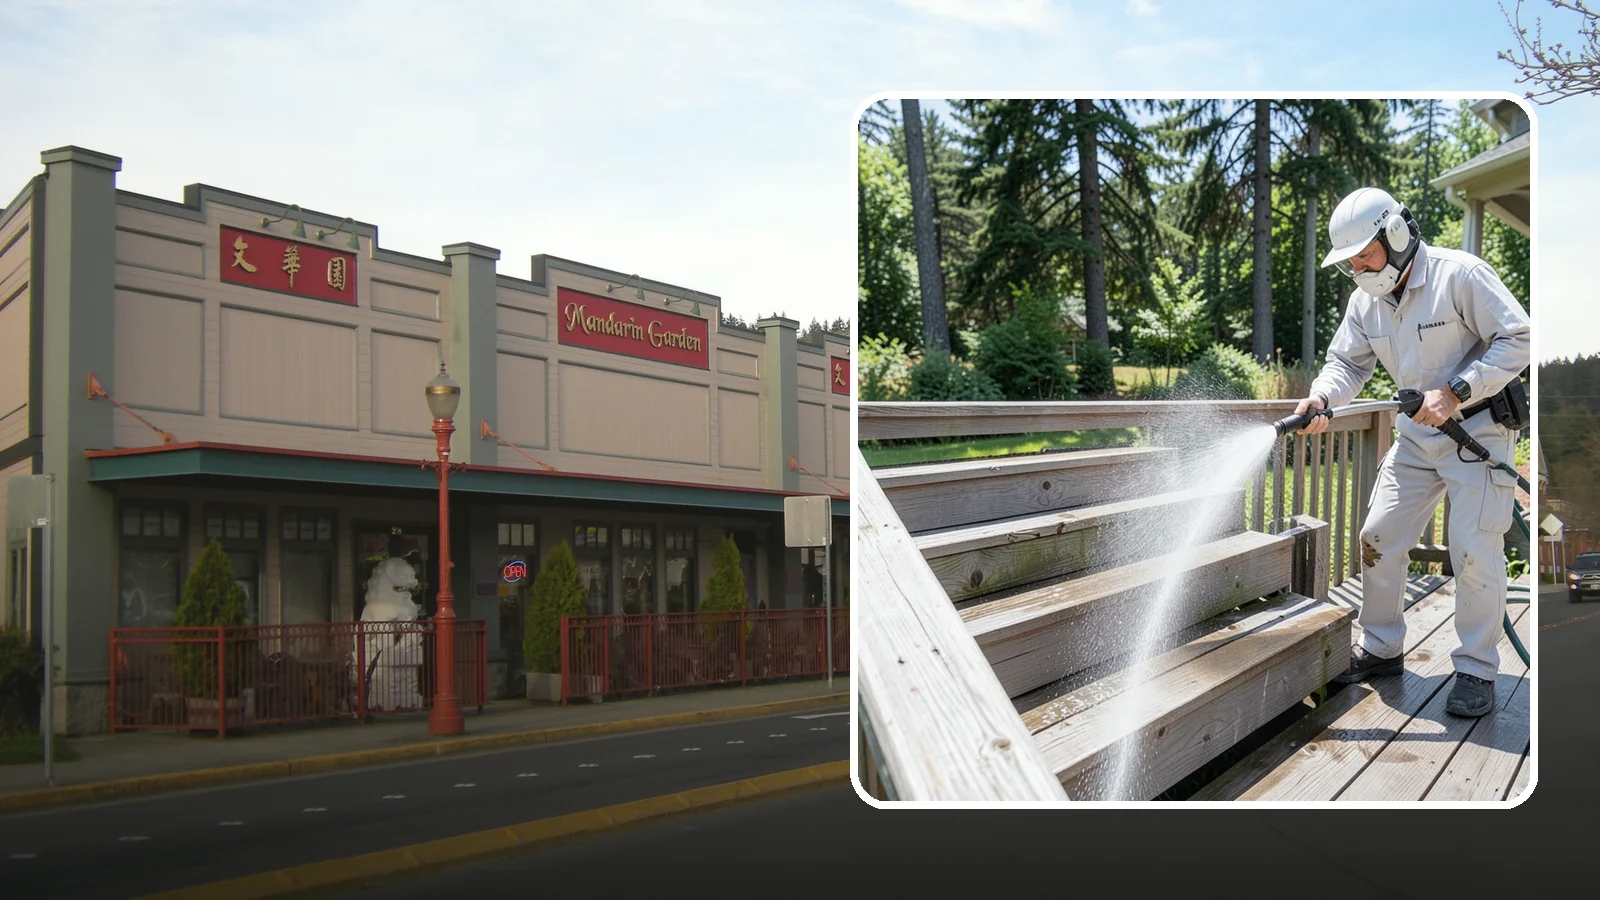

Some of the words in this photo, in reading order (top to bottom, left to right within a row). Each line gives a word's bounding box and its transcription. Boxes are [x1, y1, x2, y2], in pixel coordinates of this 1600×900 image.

[231, 236, 346, 290] 文華園
[564, 302, 644, 341] Mandarin
[648, 320, 701, 352] Garden
[503, 565, 527, 578] OPEN
